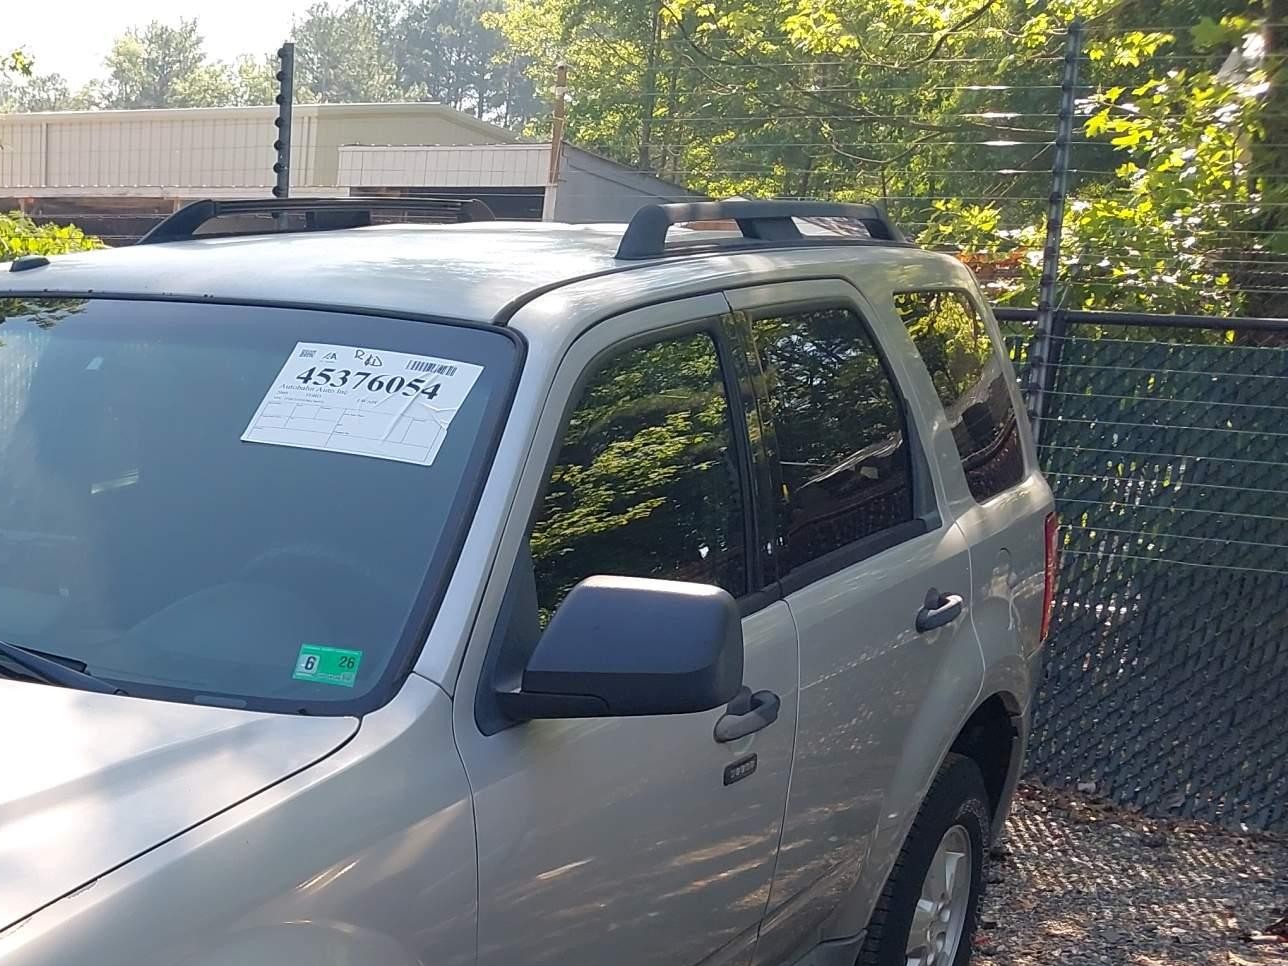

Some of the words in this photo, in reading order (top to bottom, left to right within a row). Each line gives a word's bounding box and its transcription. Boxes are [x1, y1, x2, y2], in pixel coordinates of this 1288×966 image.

[279, 383, 314, 392] Autobahn
[316, 386, 335, 394] Auto
[296, 366, 442, 400] 45376054
[305, 656, 317, 670] 6
[339, 655, 356, 670] 26
